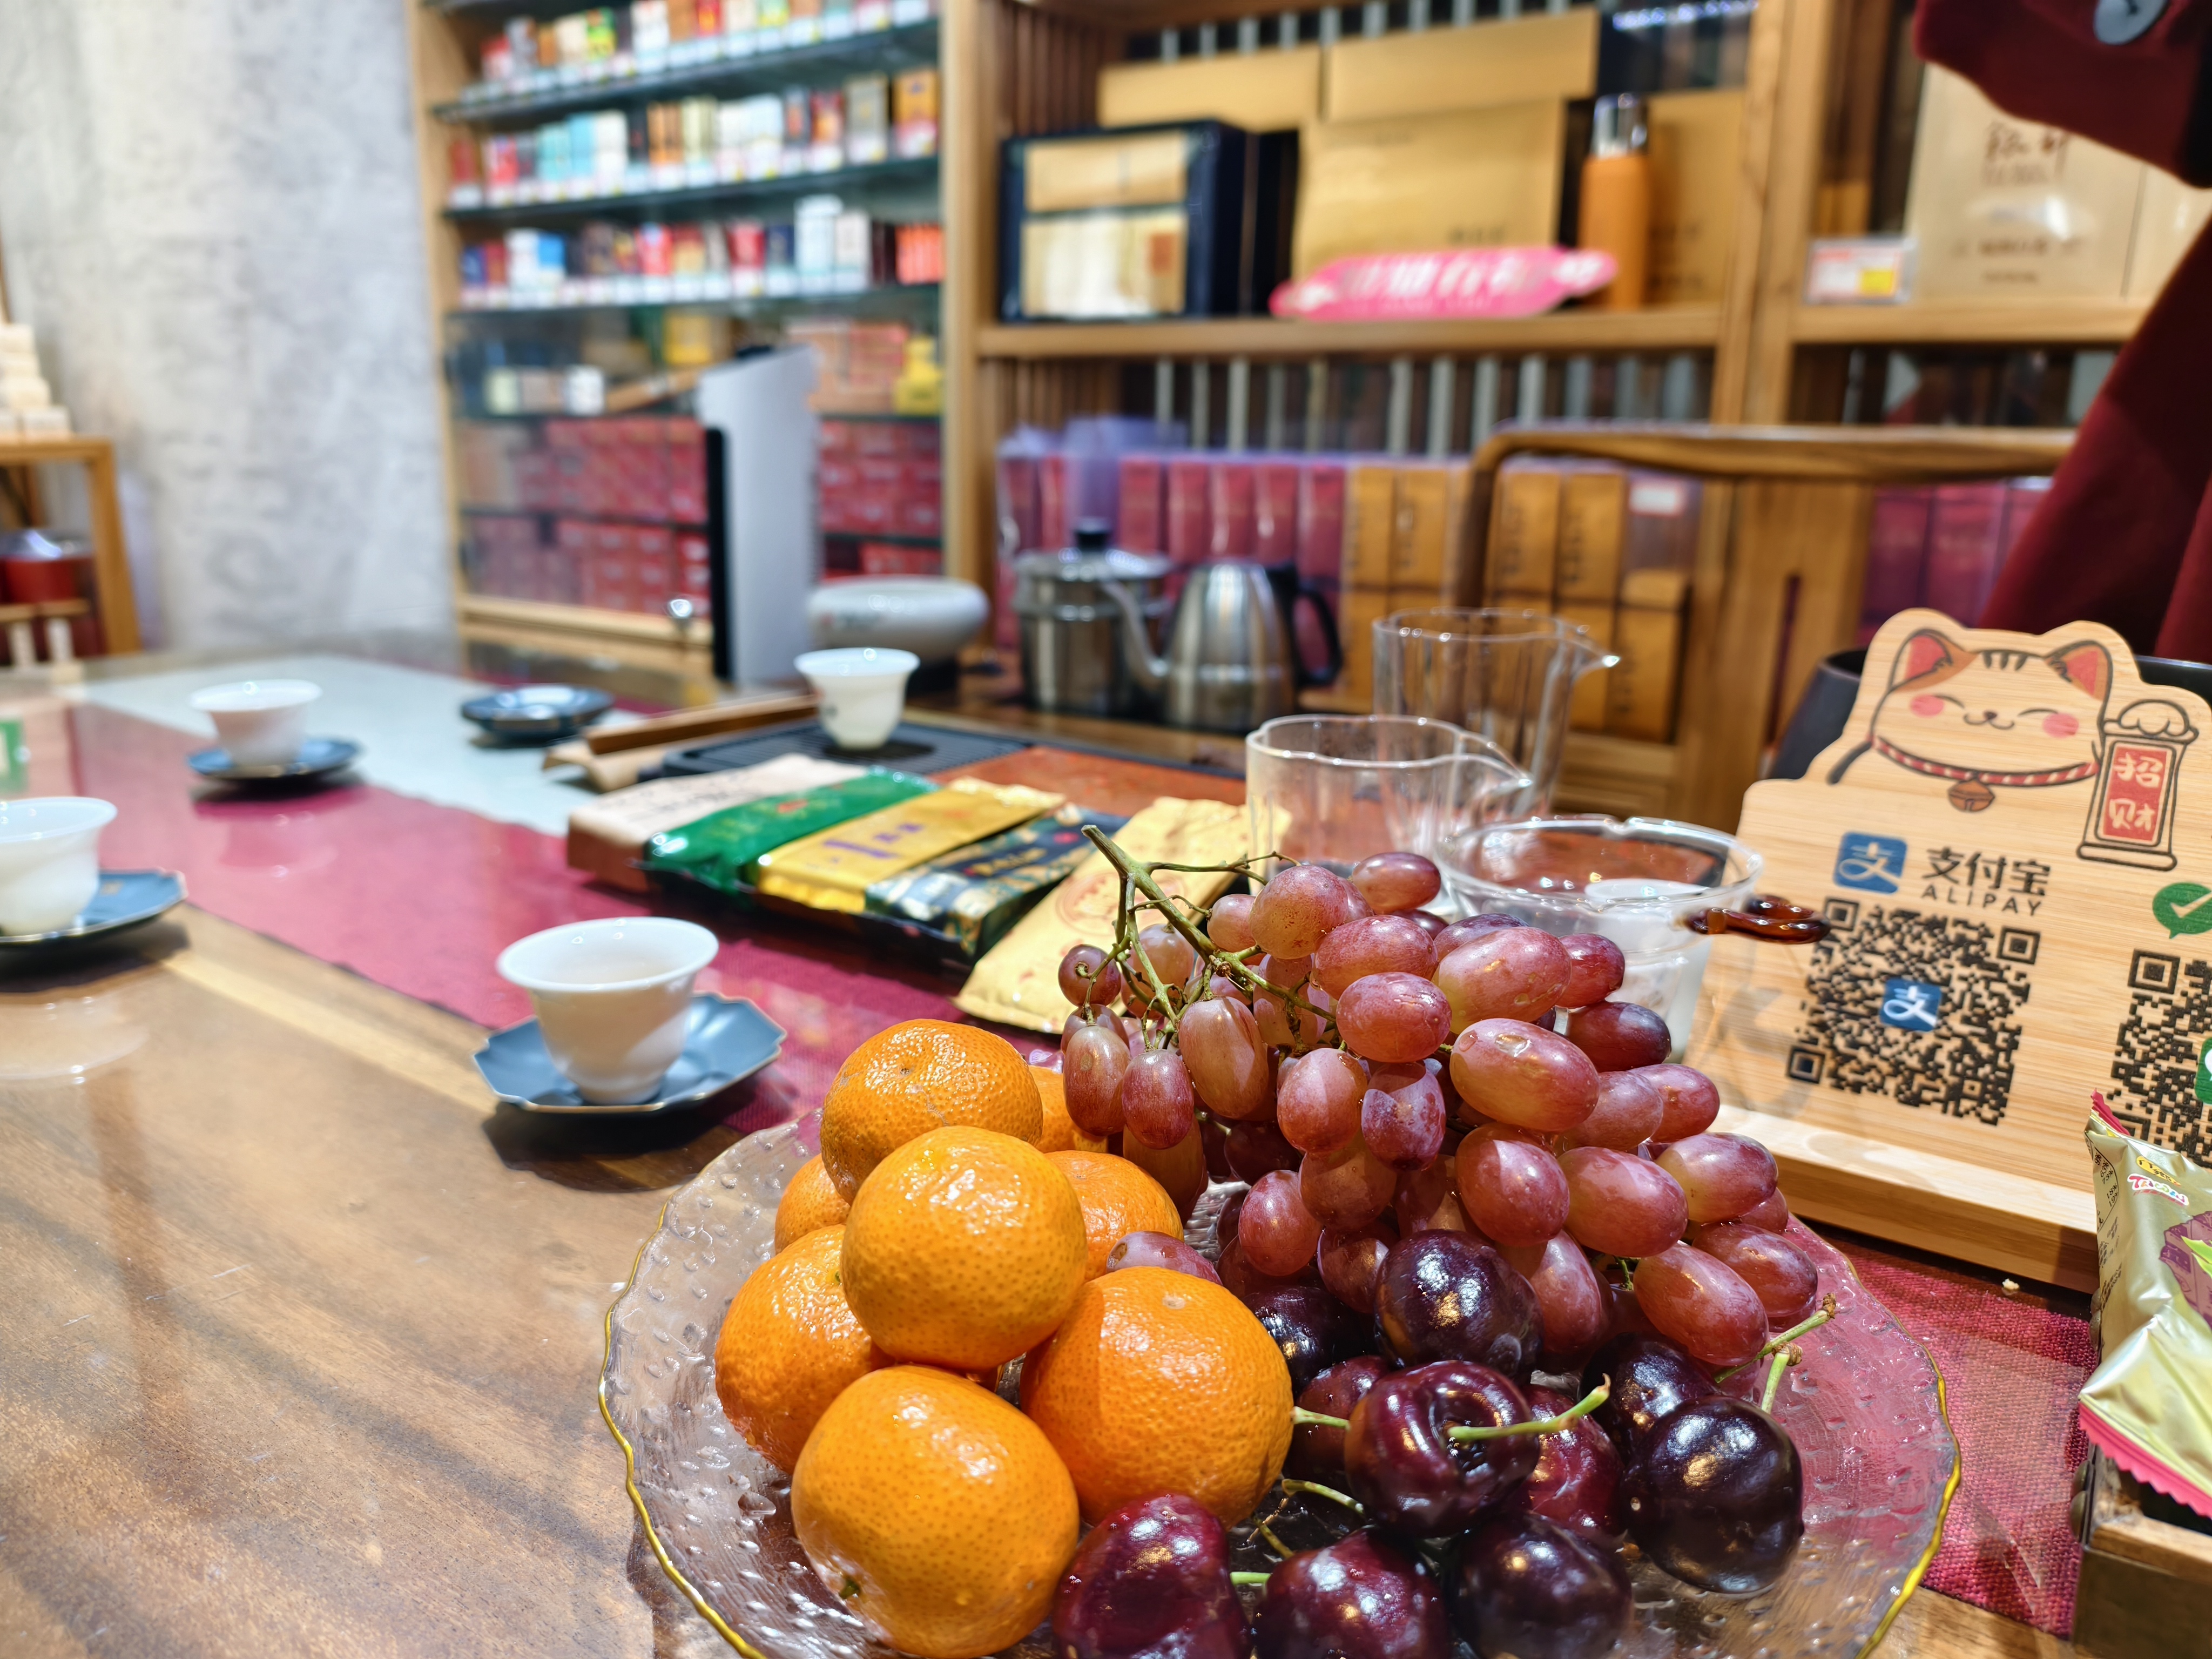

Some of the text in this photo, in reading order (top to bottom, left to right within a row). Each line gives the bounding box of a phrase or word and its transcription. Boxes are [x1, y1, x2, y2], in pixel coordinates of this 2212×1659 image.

[2109, 752, 2163, 832] 招财
[1921, 846, 2052, 896] 支付宝
[1921, 884, 2042, 916] ALIPAY
